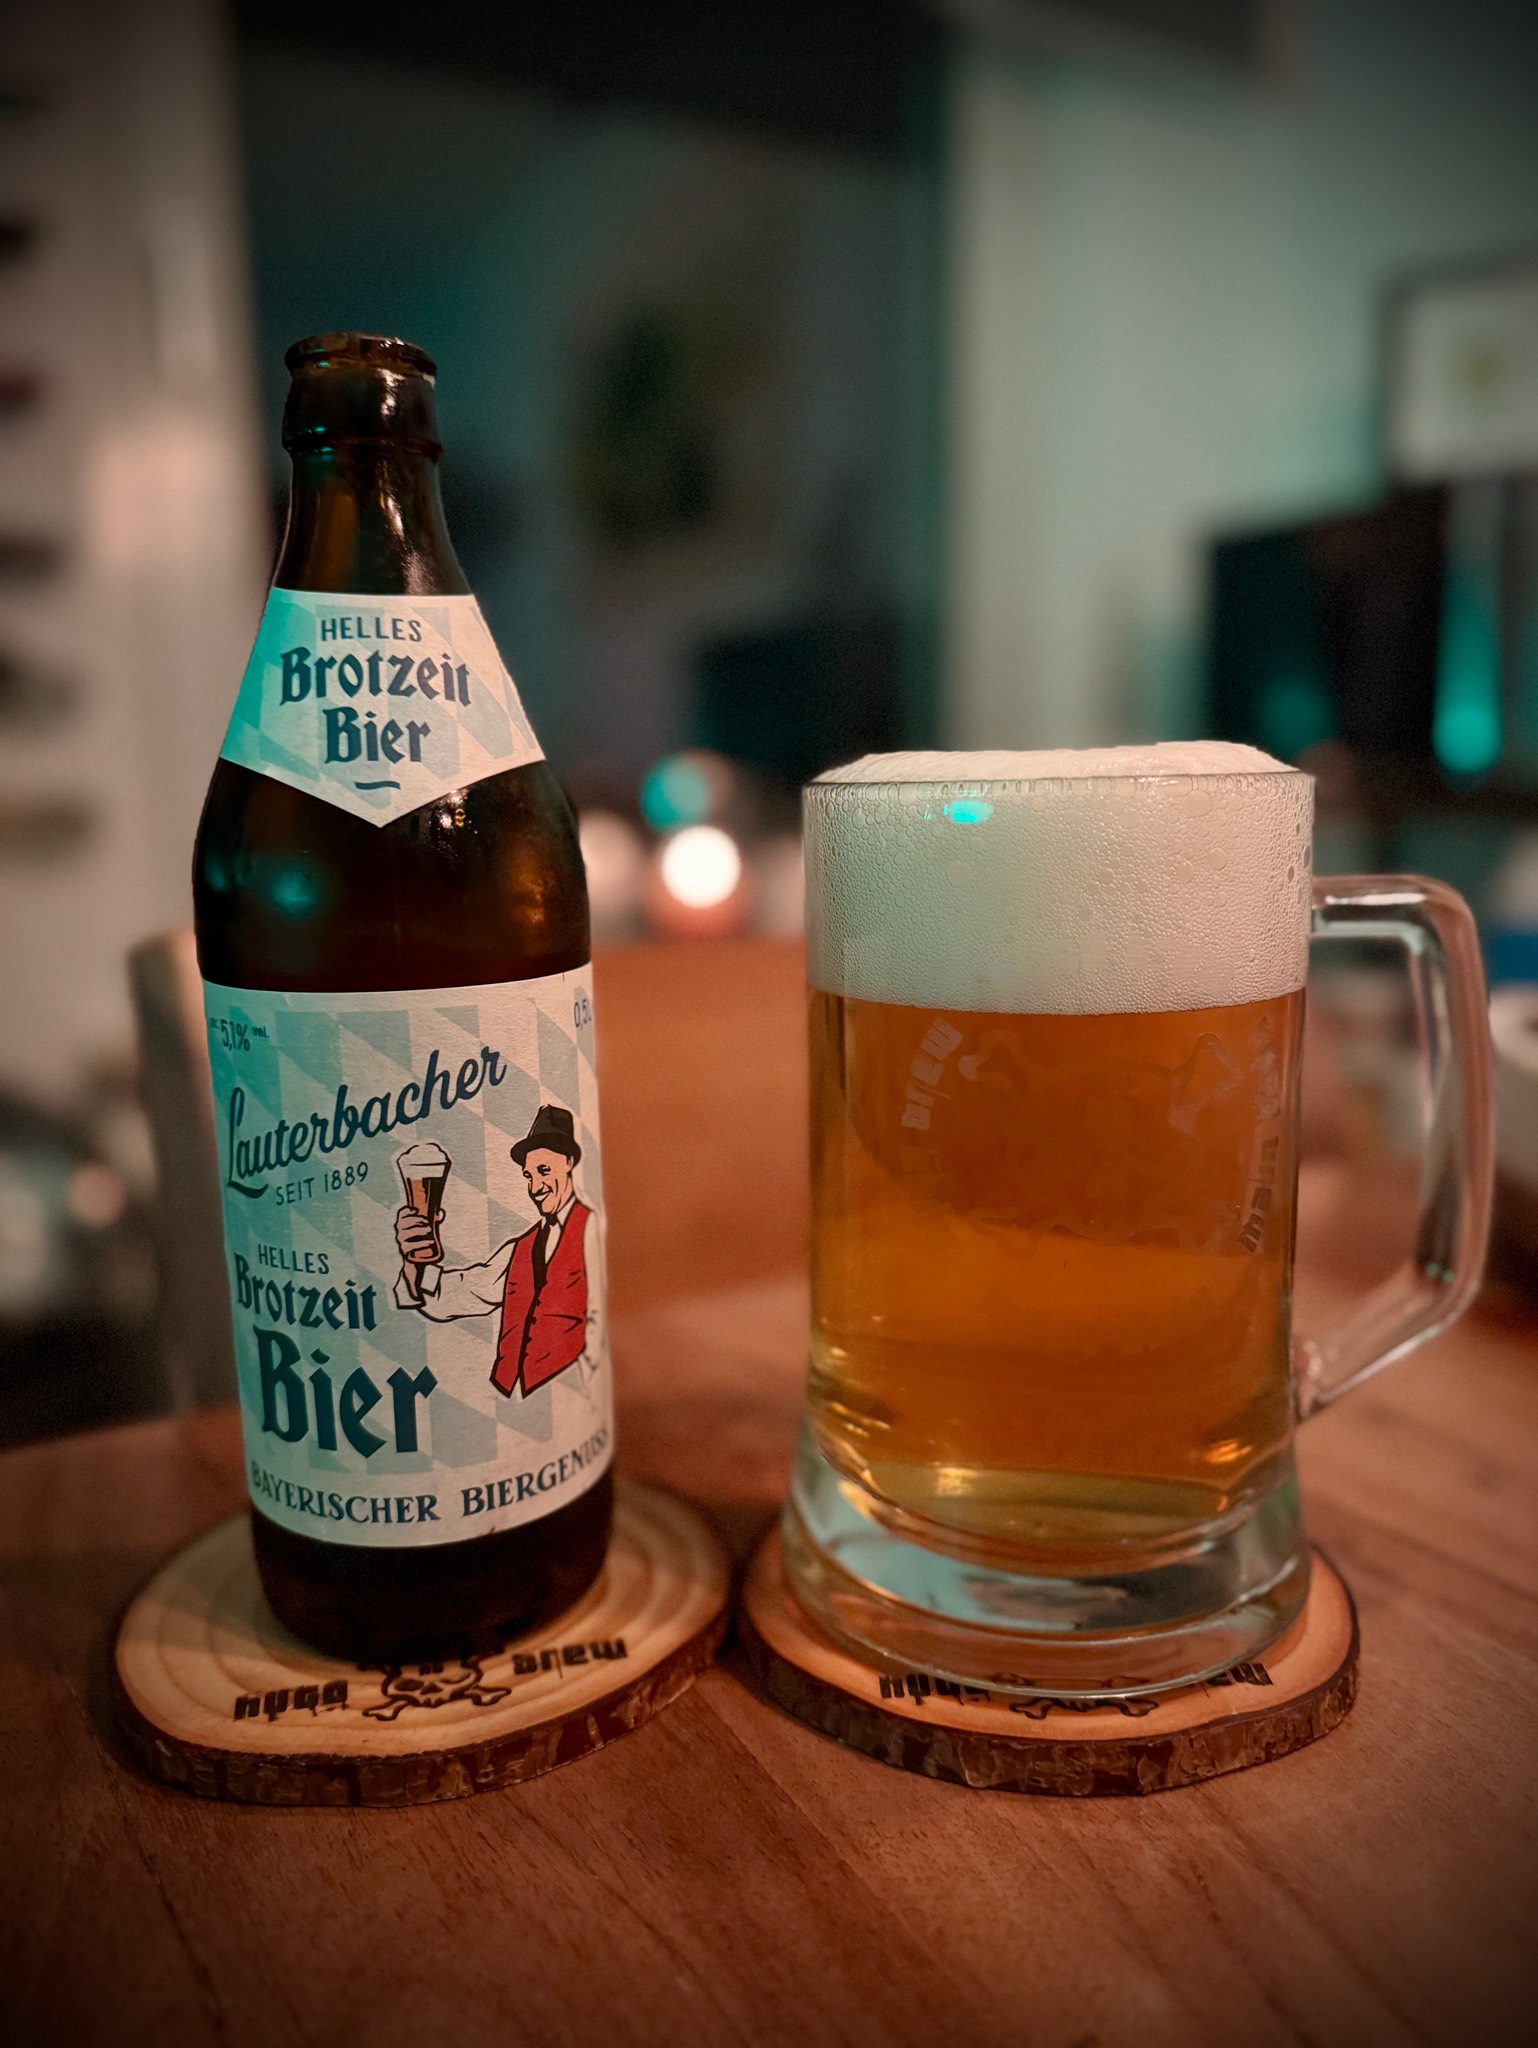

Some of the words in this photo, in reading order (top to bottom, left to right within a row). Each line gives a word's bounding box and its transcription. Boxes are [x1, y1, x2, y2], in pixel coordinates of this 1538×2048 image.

[321, 616, 423, 643] HELLES
[279, 646, 472, 707] Brotzeit
[322, 706, 431, 765] Bier
[220, 1018, 251, 1052] 5,1%
[227, 1045, 508, 1199] Lauterbacher
[276, 1176, 314, 1206] SEIT
[324, 1161, 369, 1194] 1889
[257, 1243, 330, 1275] HELLES
[234, 1251, 378, 1332] Brotzeit
[253, 1324, 438, 1459] Bier
[250, 1458, 441, 1524] BAYERISCHER
